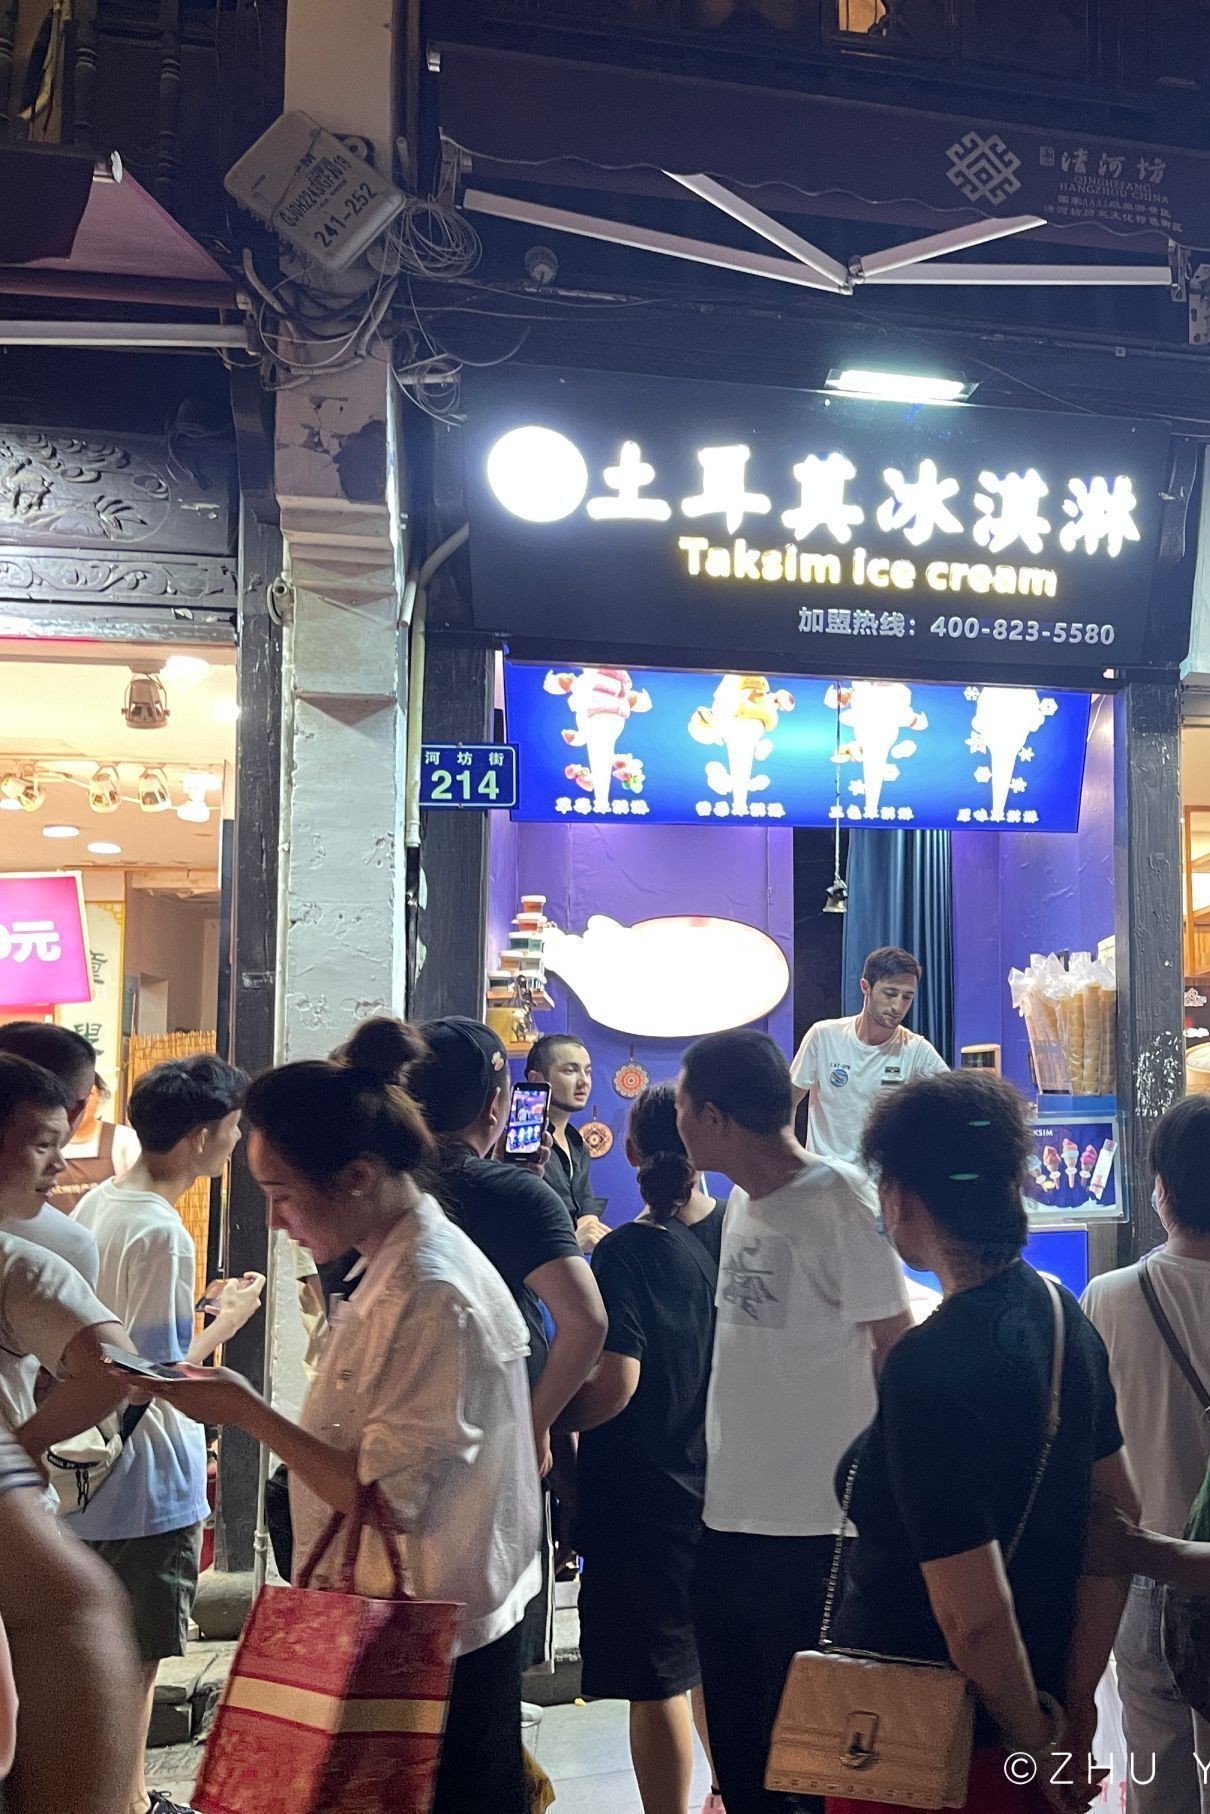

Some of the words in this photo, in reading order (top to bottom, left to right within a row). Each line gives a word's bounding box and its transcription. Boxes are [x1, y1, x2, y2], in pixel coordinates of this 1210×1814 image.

[925, 560, 1059, 598] cream
[930, 615, 1116, 646] 400-823-5580
[425, 751, 504, 767] 河坊街
[431, 769, 499, 800] 214
